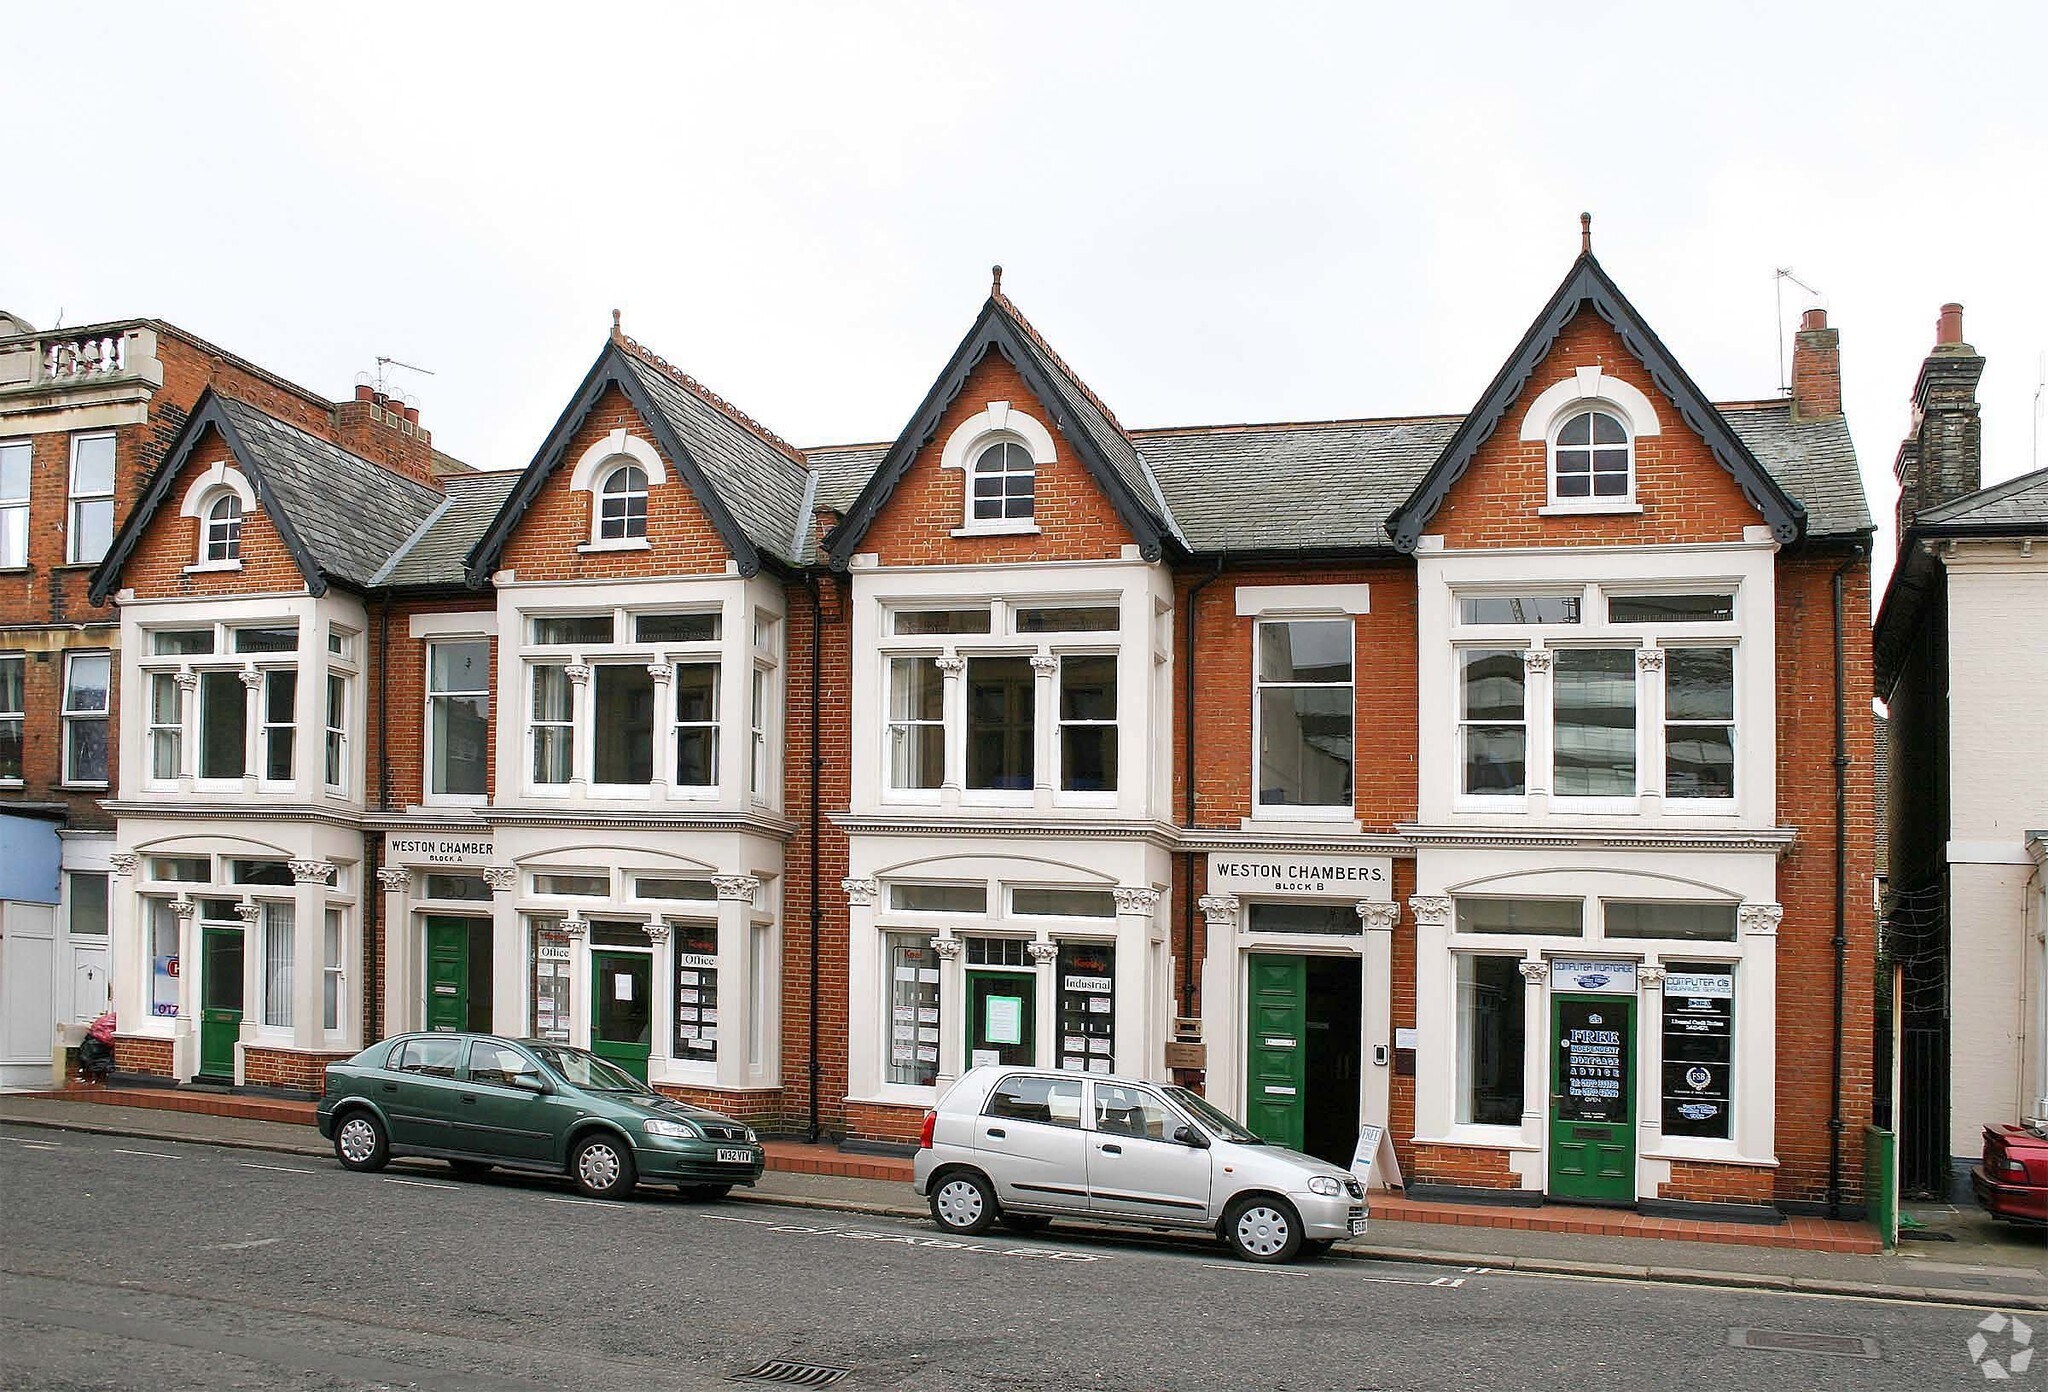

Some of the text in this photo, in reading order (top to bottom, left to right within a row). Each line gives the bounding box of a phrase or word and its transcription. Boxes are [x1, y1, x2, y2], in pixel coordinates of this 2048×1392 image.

[392, 840, 435, 853] WESTON
[429, 855, 454, 863] BLOCK
[1216, 863, 1386, 882] WESTON CHAMBERS.
[1275, 882, 1325, 891] BLOCK B
[541, 947, 569, 959] Office
[685, 954, 715, 966] Office
[1554, 962, 1593, 971] COMPUTER
[1066, 978, 1111, 990] Industrial
[1666, 976, 1715, 987] COMPUTER
[1570, 1029, 1620, 1045] FREE
[1570, 1044, 1620, 1054] INDEPENDENT
[1570, 1056, 1620, 1066] MORTGAGE
[1569, 1067, 1620, 1078] ADVICE
[1692, 1072, 1706, 1081] FSB
[1362, 1127, 1381, 1142] FREE
